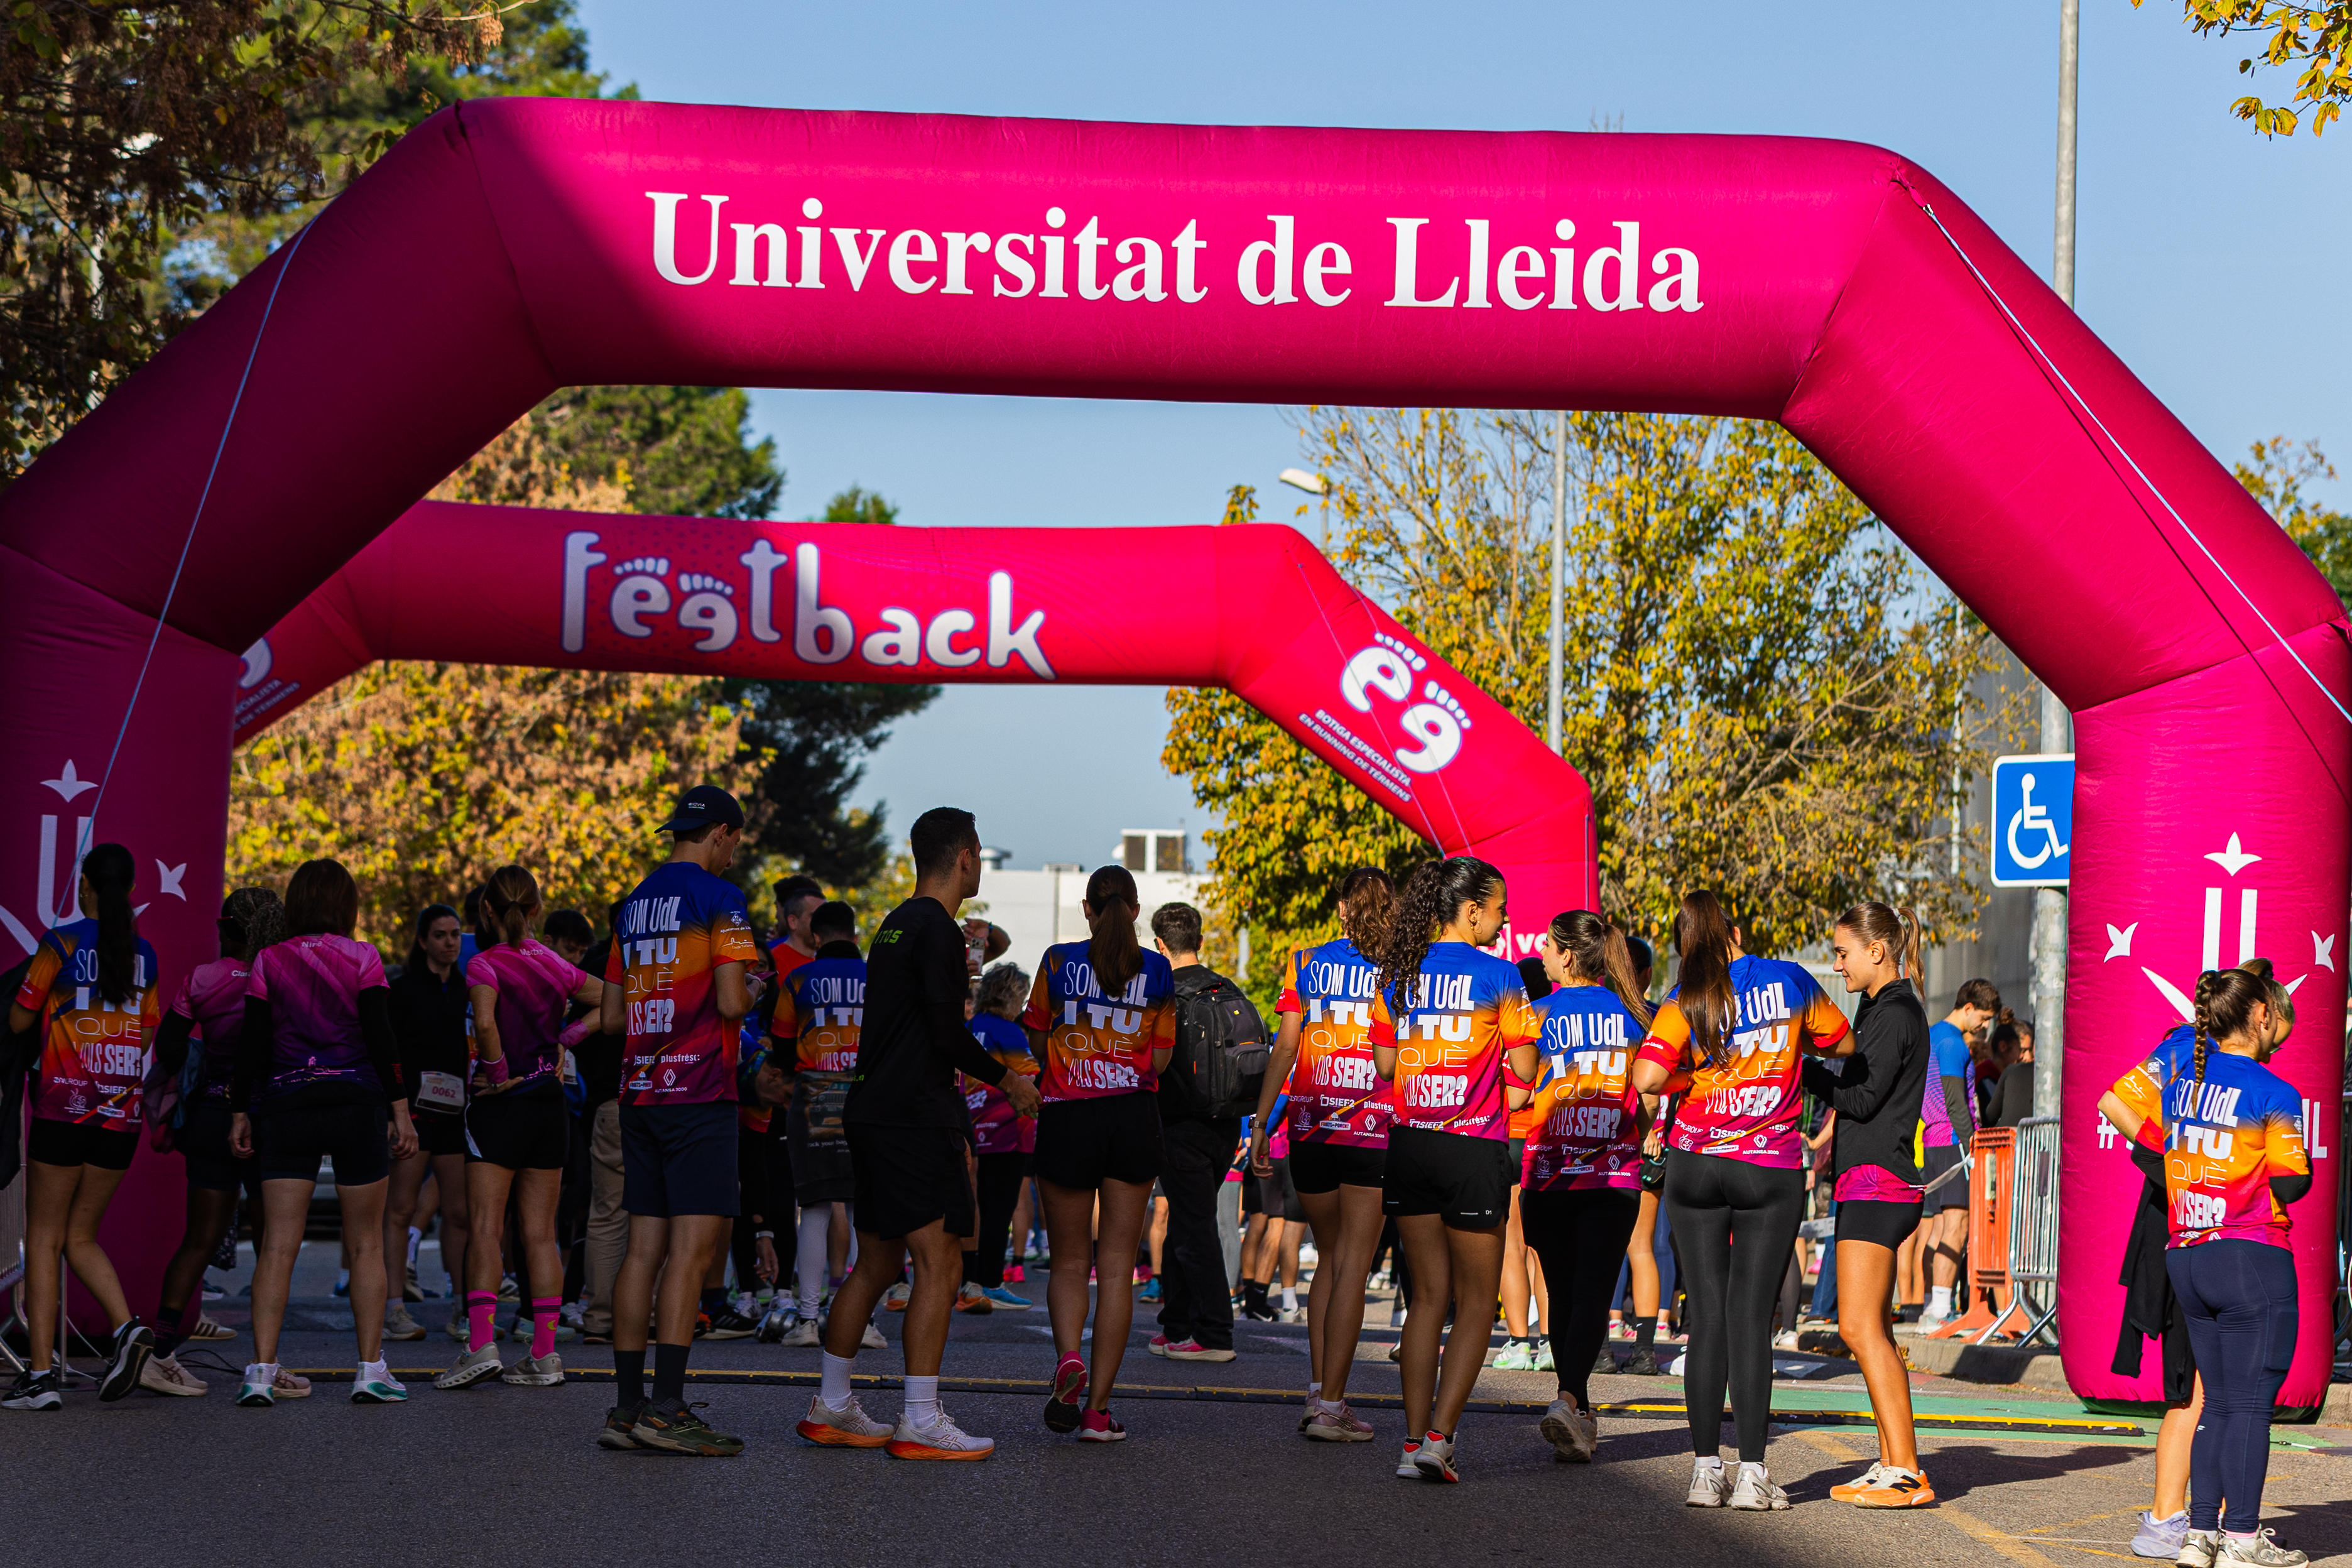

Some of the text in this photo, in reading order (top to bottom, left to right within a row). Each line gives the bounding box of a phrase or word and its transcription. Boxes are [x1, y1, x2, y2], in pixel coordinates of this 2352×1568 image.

[645, 190, 1704, 313] Universitat de Lleida
[562, 531, 1057, 680] feetback
[1298, 712, 1314, 727] EN
[1312, 724, 1357, 761] RUNNING
[1354, 755, 1369, 771] DE
[1315, 709, 1412, 787] BOTIGA ESPECIALISTA
[623, 896, 681, 937] SOM UdL
[75, 949, 99, 981] SO
[1309, 961, 1346, 996] SOM
[810, 977, 842, 1004] SOM
[1434, 974, 1475, 1011] UdL
[1745, 981, 1790, 1025] UdL
[75, 1017, 142, 1040] QUÈ
[1065, 1032, 1133, 1059] QUÈ
[1311, 1029, 1374, 1052] QUÈ
[1546, 1013, 1629, 1051] SOM UdL
[104, 1043, 142, 1077] SER?
[1398, 1043, 1469, 1068] QUÈ
[1093, 1060, 1140, 1089] SER?
[1332, 1056, 1378, 1091] SER?
[1554, 1078, 1623, 1101] QUÈ
[432, 1086, 456, 1098] 0062
[1419, 1074, 1469, 1108] SER?
[1729, 1086, 1782, 1117] SER?
[2201, 1084, 2242, 1128] UdL
[1574, 1106, 1621, 1139] SER?
[2172, 1159, 2227, 1189] QUÈ
